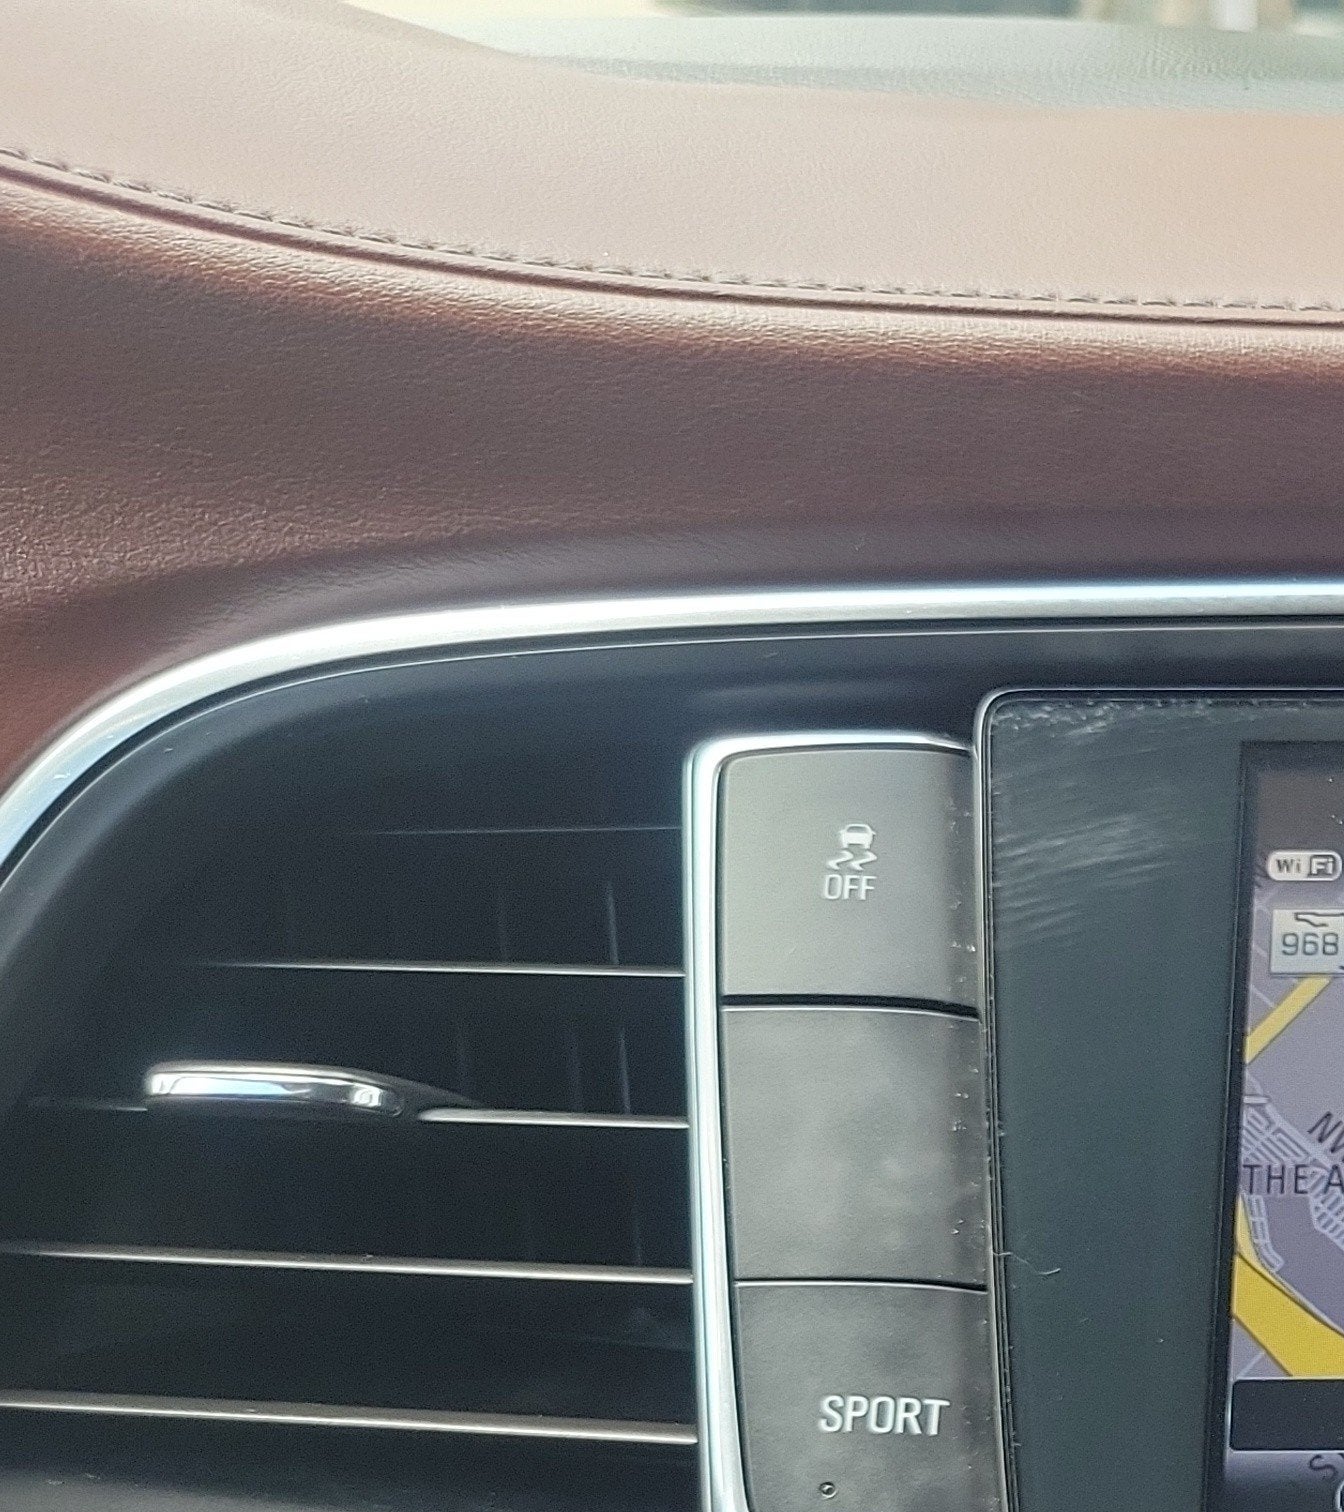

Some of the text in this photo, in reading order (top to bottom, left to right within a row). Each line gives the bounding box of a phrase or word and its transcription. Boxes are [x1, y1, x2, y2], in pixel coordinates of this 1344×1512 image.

[823, 873, 878, 901] OFF
[1281, 932, 1340, 957] 968
[1242, 1163, 1310, 1195] THE
[819, 1394, 951, 1437] SPORT
